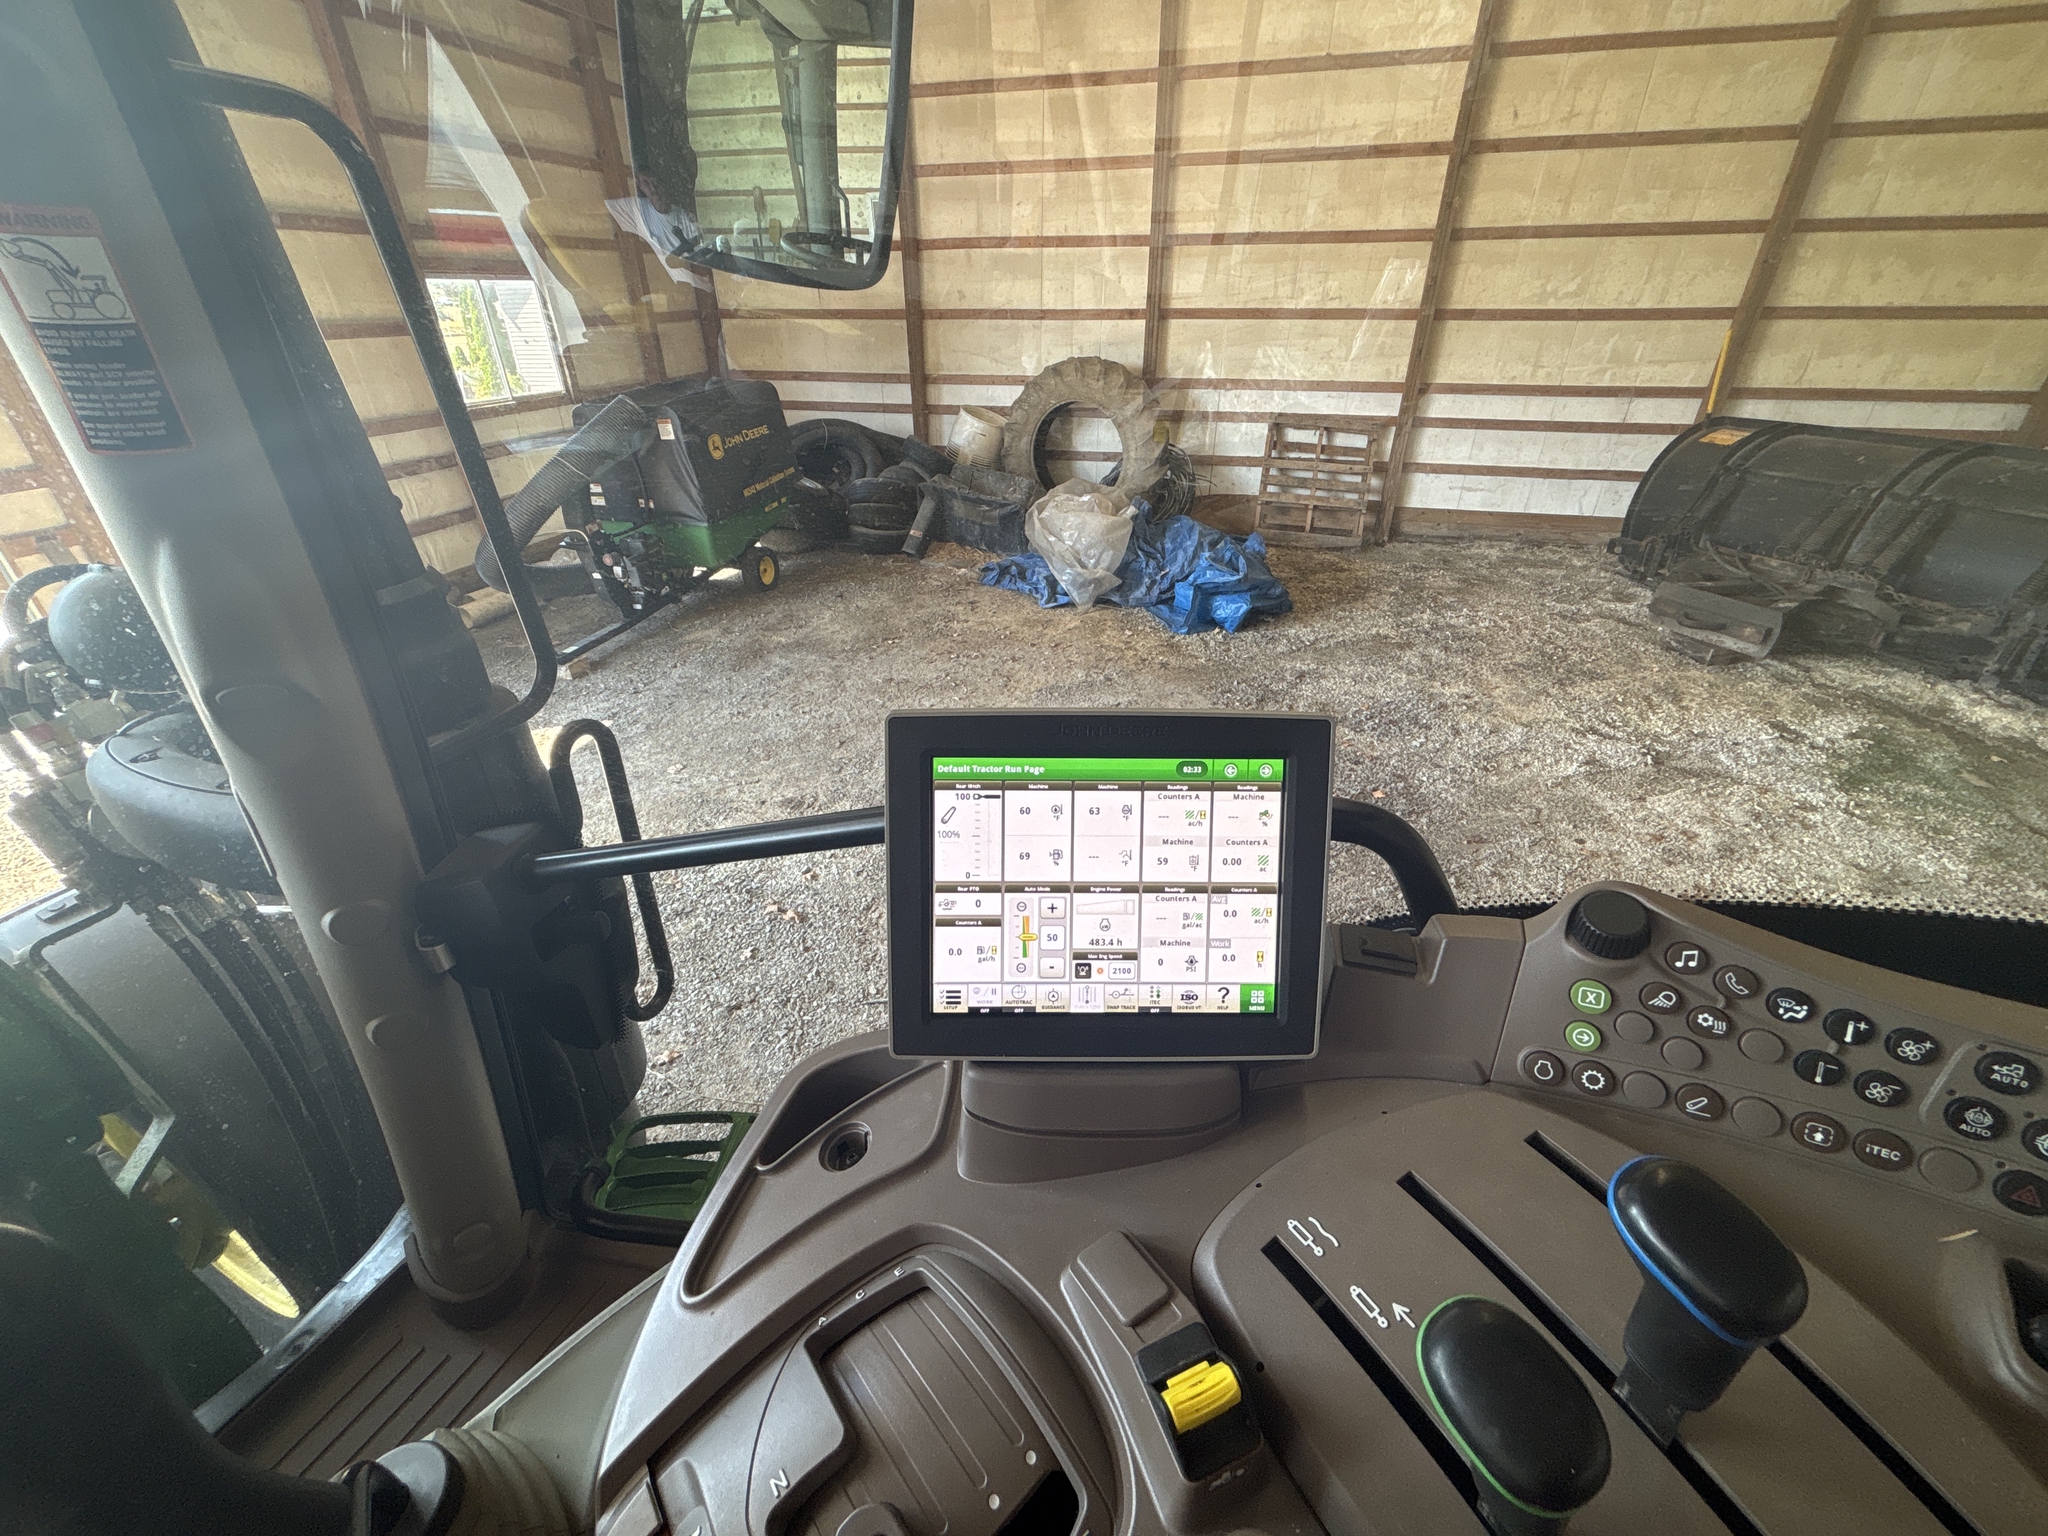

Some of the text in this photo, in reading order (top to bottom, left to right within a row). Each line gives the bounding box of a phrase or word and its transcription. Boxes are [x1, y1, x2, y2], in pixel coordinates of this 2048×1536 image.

[724, 425, 770, 448] JOHN DEERE
[937, 765, 970, 773] Default
[972, 765, 1003, 773] Tractor
[1024, 766, 1045, 775] Page
[1089, 807, 1100, 815] 63
[1019, 852, 1030, 860] 69
[1089, 938, 1122, 946] 483.4 h
[1222, 954, 1235, 962] 0.0
[1990, 1072, 2029, 1089] AUTO
[1959, 1123, 1991, 1138] AUTO
[1866, 1144, 1901, 1161] iTEC
[818, 1267, 905, 1327] A C E
[769, 1468, 790, 1498] N
